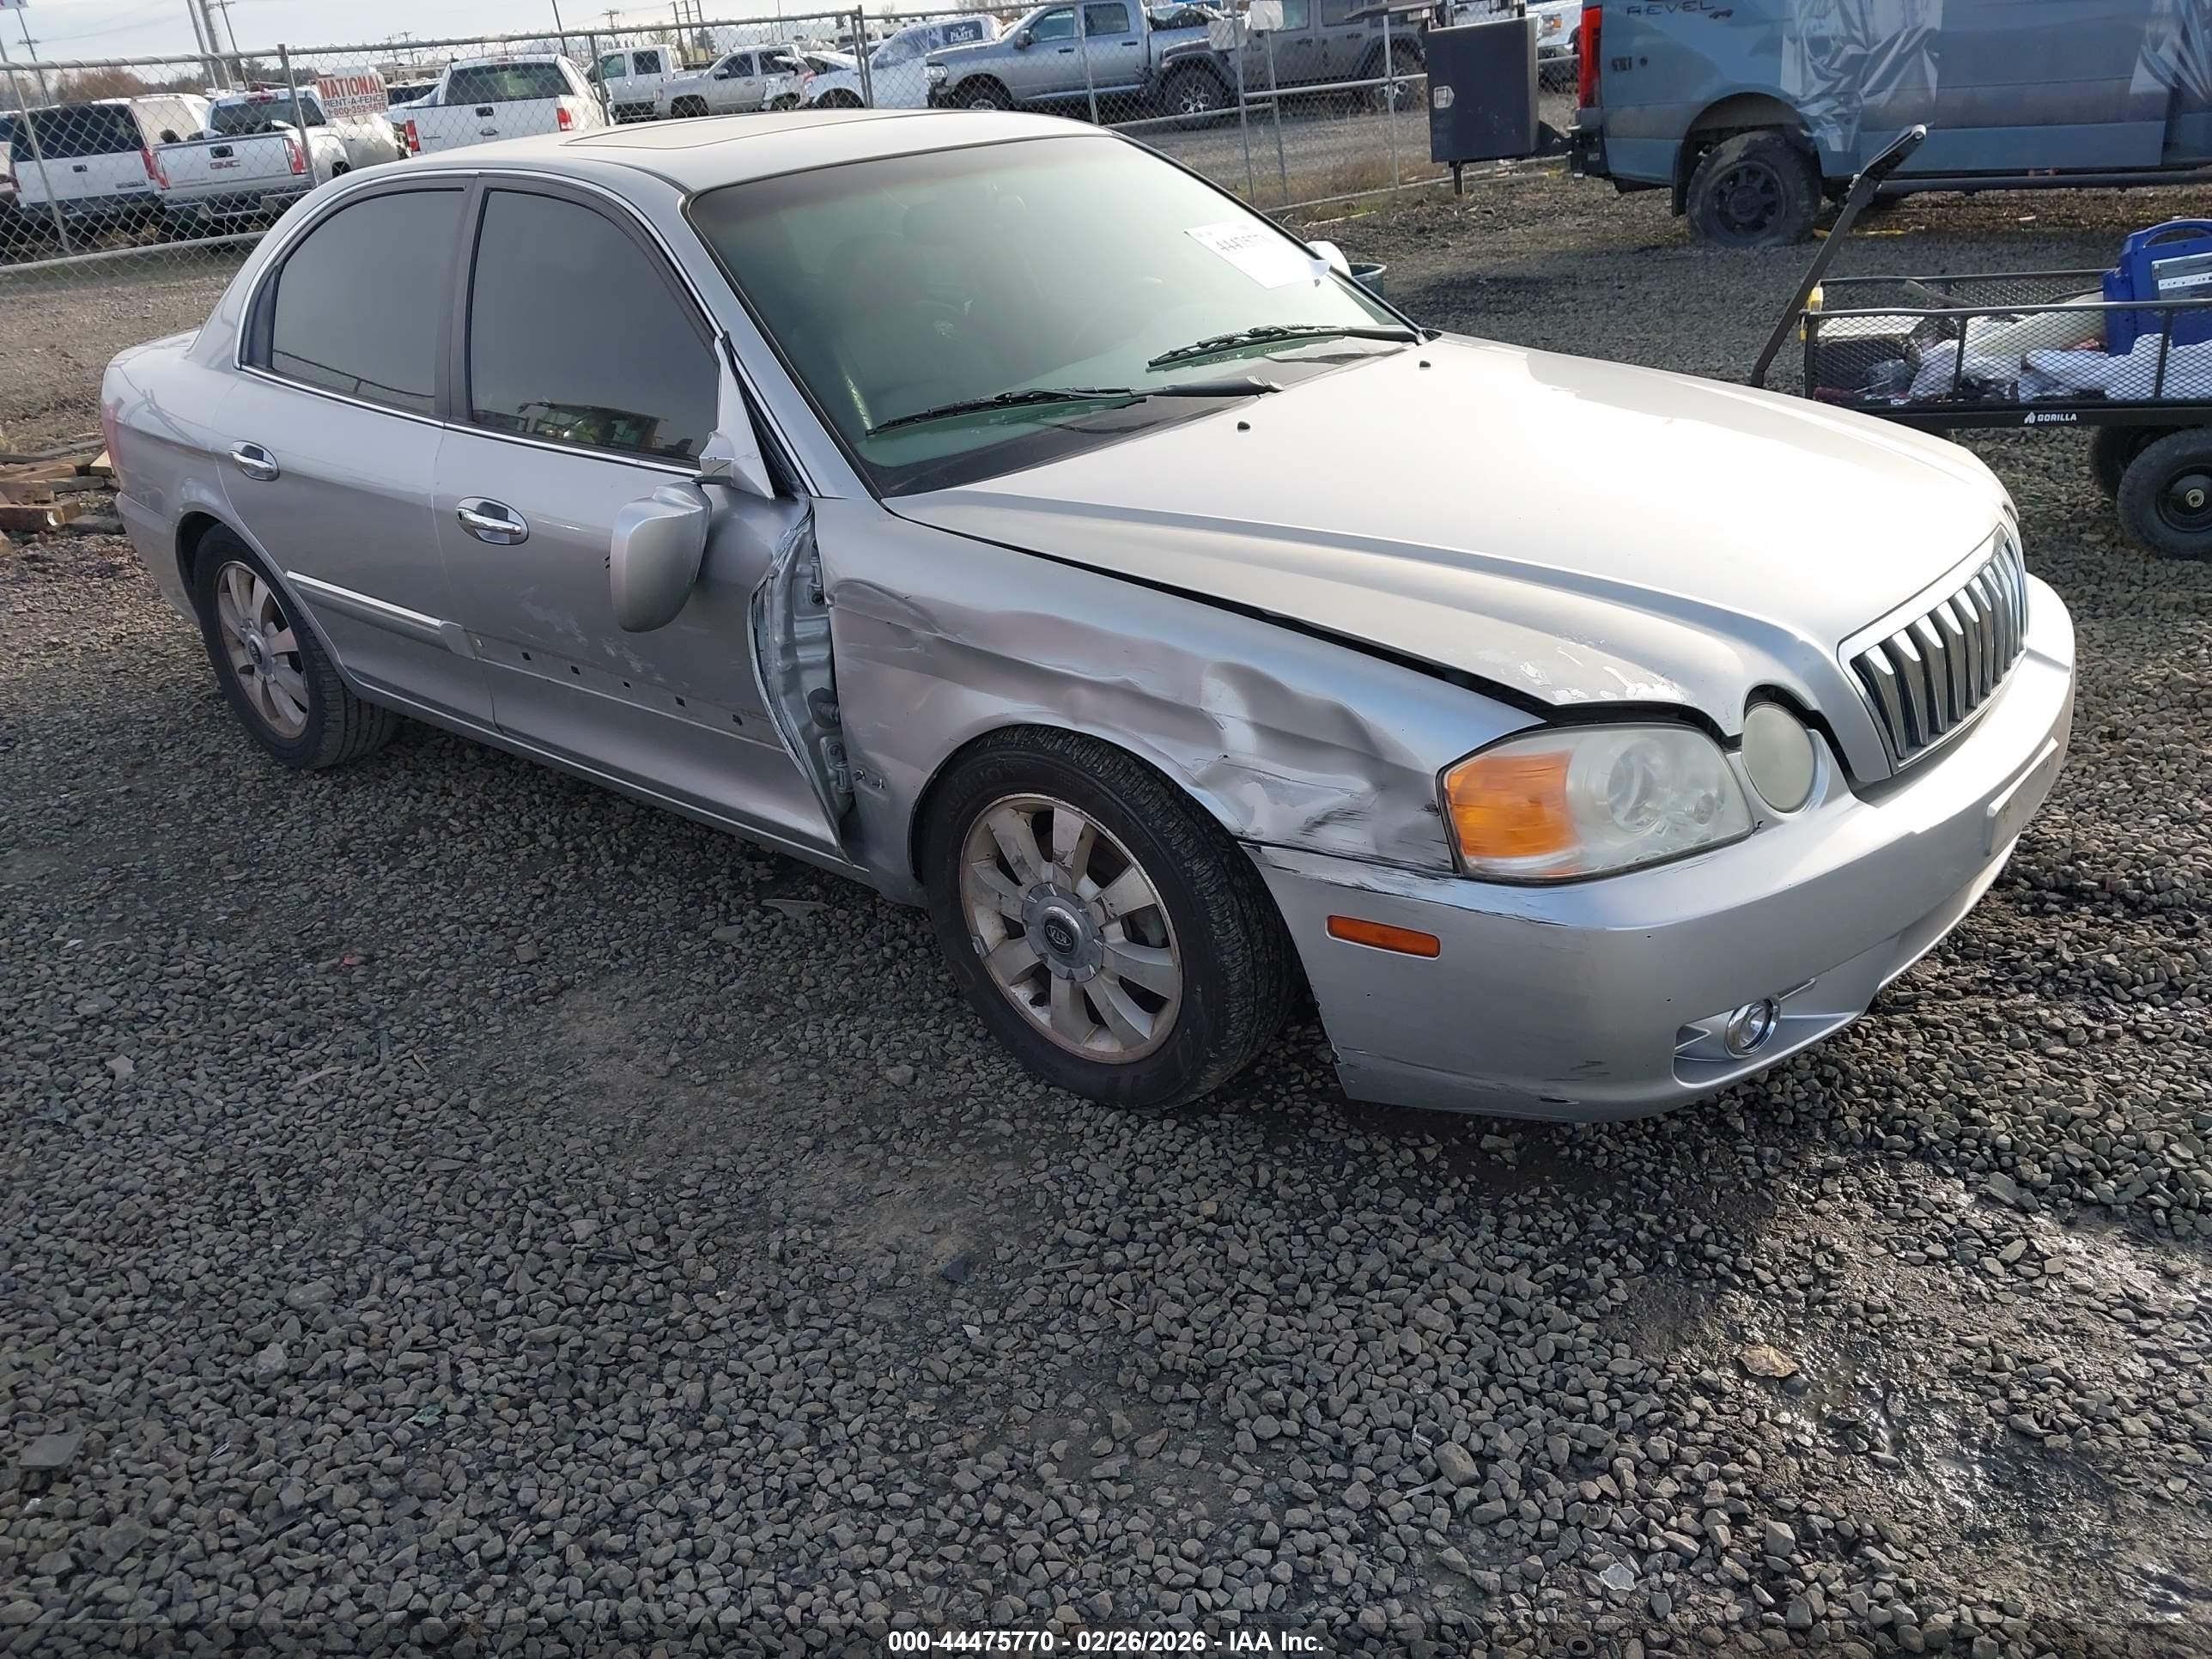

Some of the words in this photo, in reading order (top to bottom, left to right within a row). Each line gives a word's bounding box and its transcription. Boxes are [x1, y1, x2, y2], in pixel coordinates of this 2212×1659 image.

[318, 75, 385, 100] NATIONAL
[323, 94, 386, 108] RENT-A-FENCE
[210, 160, 241, 170] GMC
[2037, 413, 2077, 422] GORILLA
